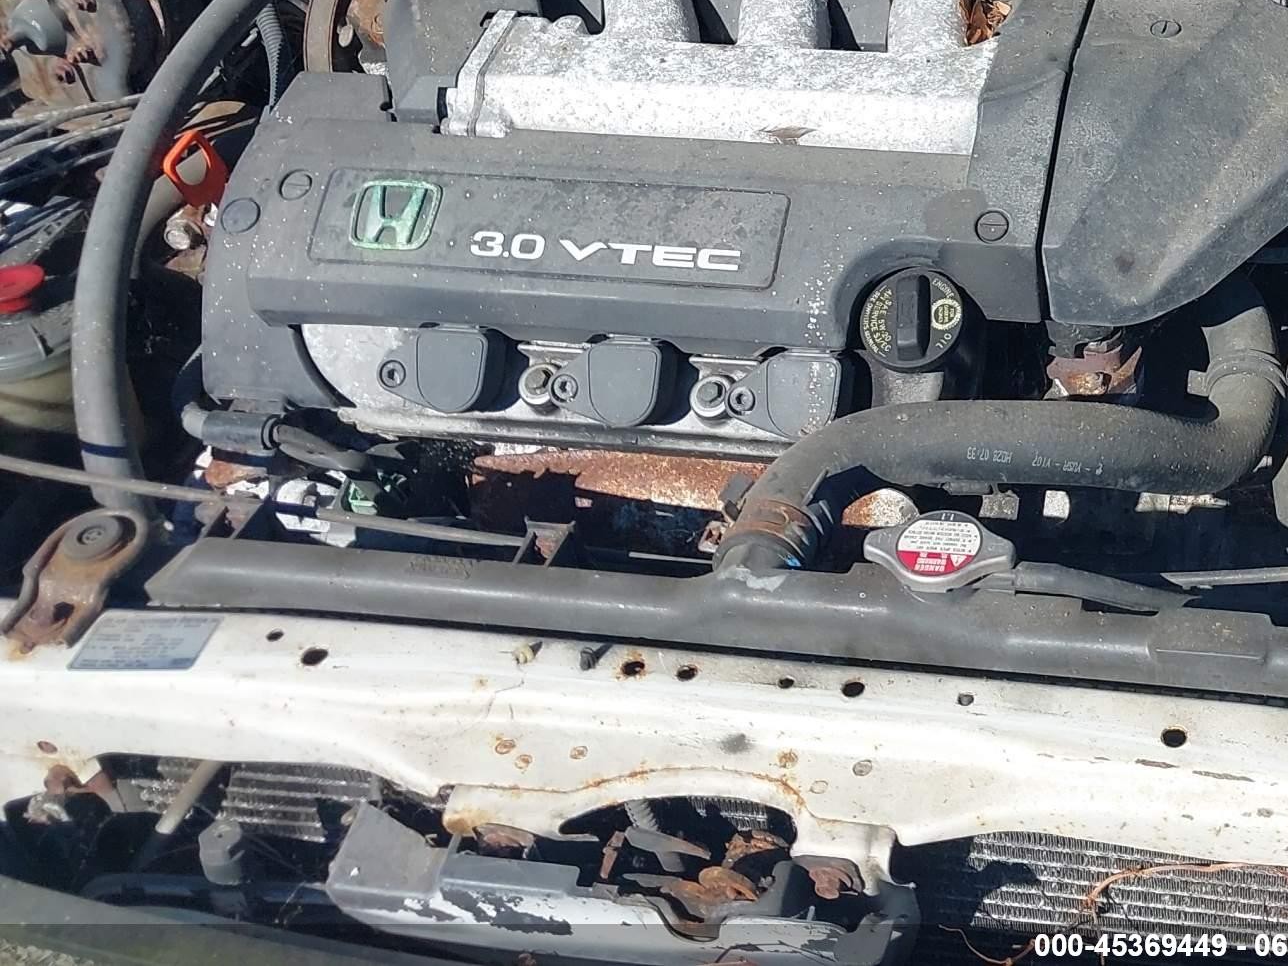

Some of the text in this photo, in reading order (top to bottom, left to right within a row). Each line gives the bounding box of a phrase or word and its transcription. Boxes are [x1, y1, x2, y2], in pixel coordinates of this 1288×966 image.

[469, 231, 741, 271] 3.0 VTEC
[870, 301, 883, 332] SERVICE
[935, 333, 952, 349] OIL
[914, 564, 946, 572] DANGER
